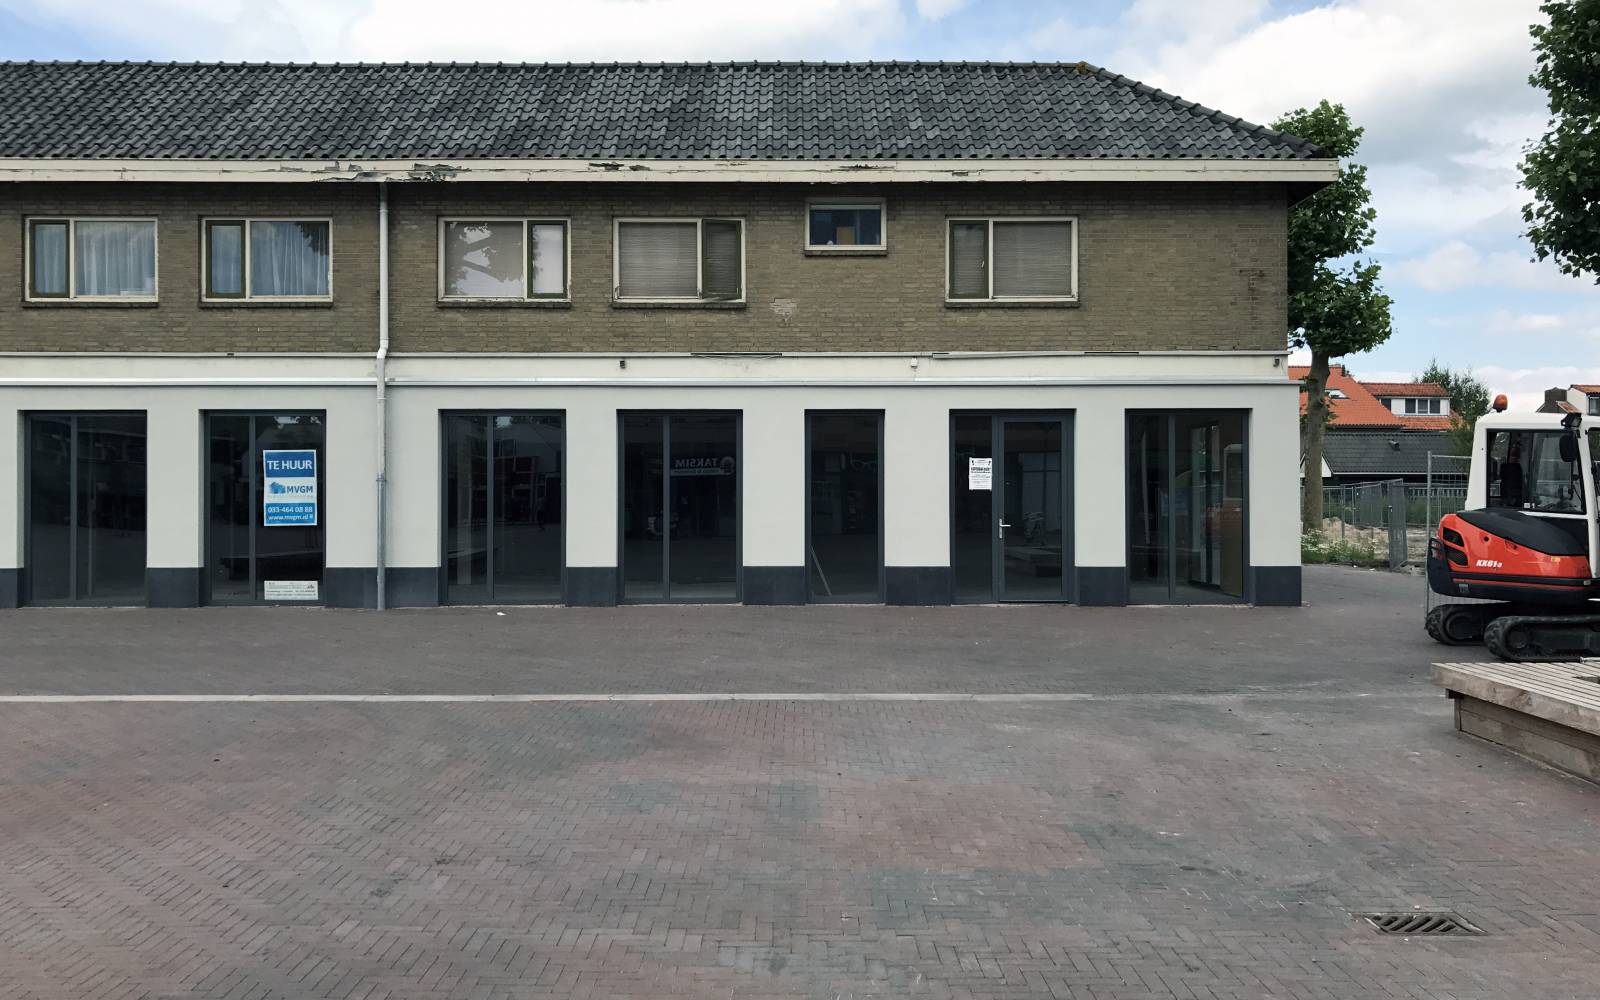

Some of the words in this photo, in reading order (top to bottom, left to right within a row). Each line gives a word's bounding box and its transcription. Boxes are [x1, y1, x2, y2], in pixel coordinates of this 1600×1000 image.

[266, 460, 280, 470] TE
[281, 460, 313, 470] HUUR
[286, 485, 313, 494] MVGM
